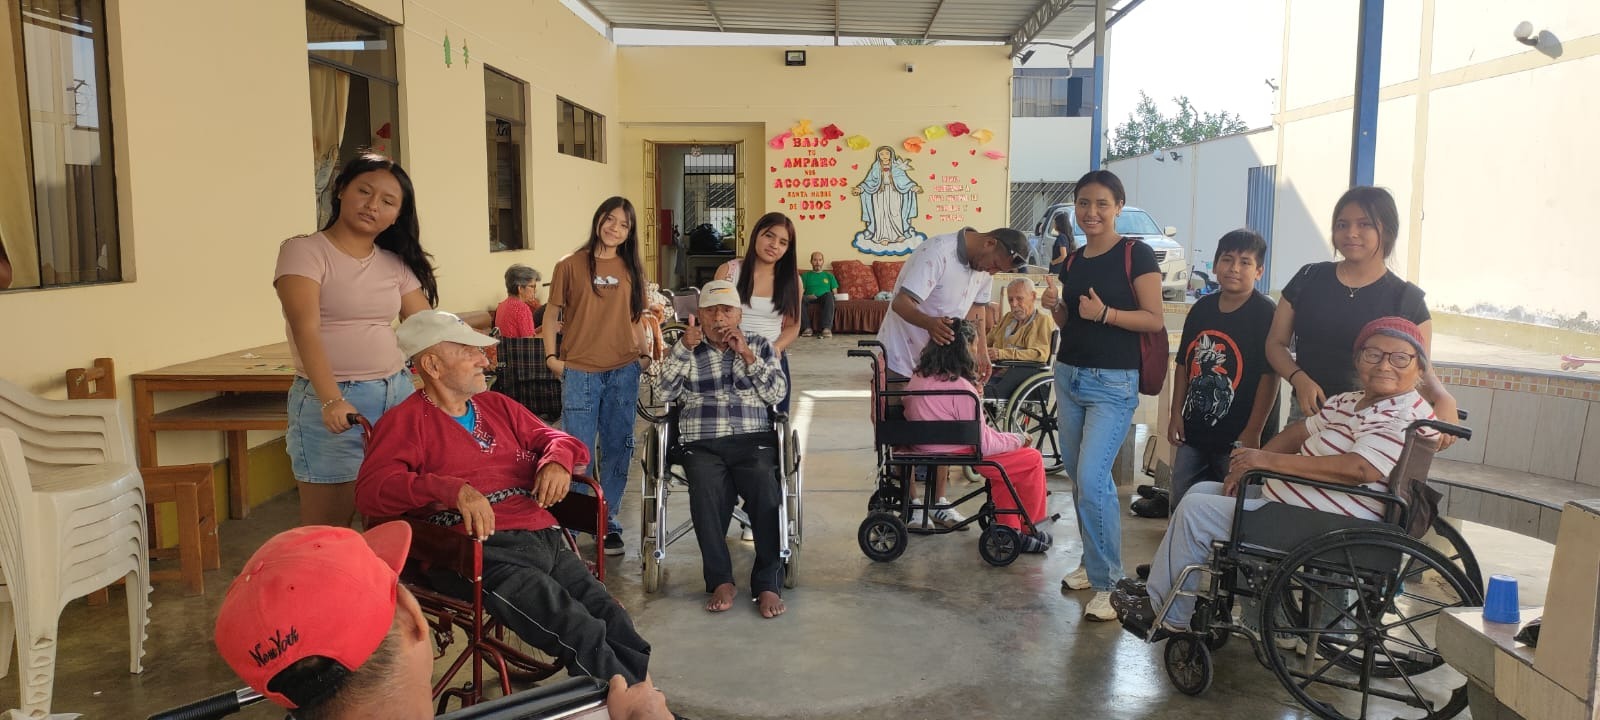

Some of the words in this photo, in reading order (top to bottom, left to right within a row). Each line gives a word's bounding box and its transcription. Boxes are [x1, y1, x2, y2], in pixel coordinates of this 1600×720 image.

[793, 138, 828, 147] BAJO
[784, 157, 837, 168] AMPARO
[774, 178, 848, 188] ACOGEMOS
[802, 201, 832, 210] DIOS
